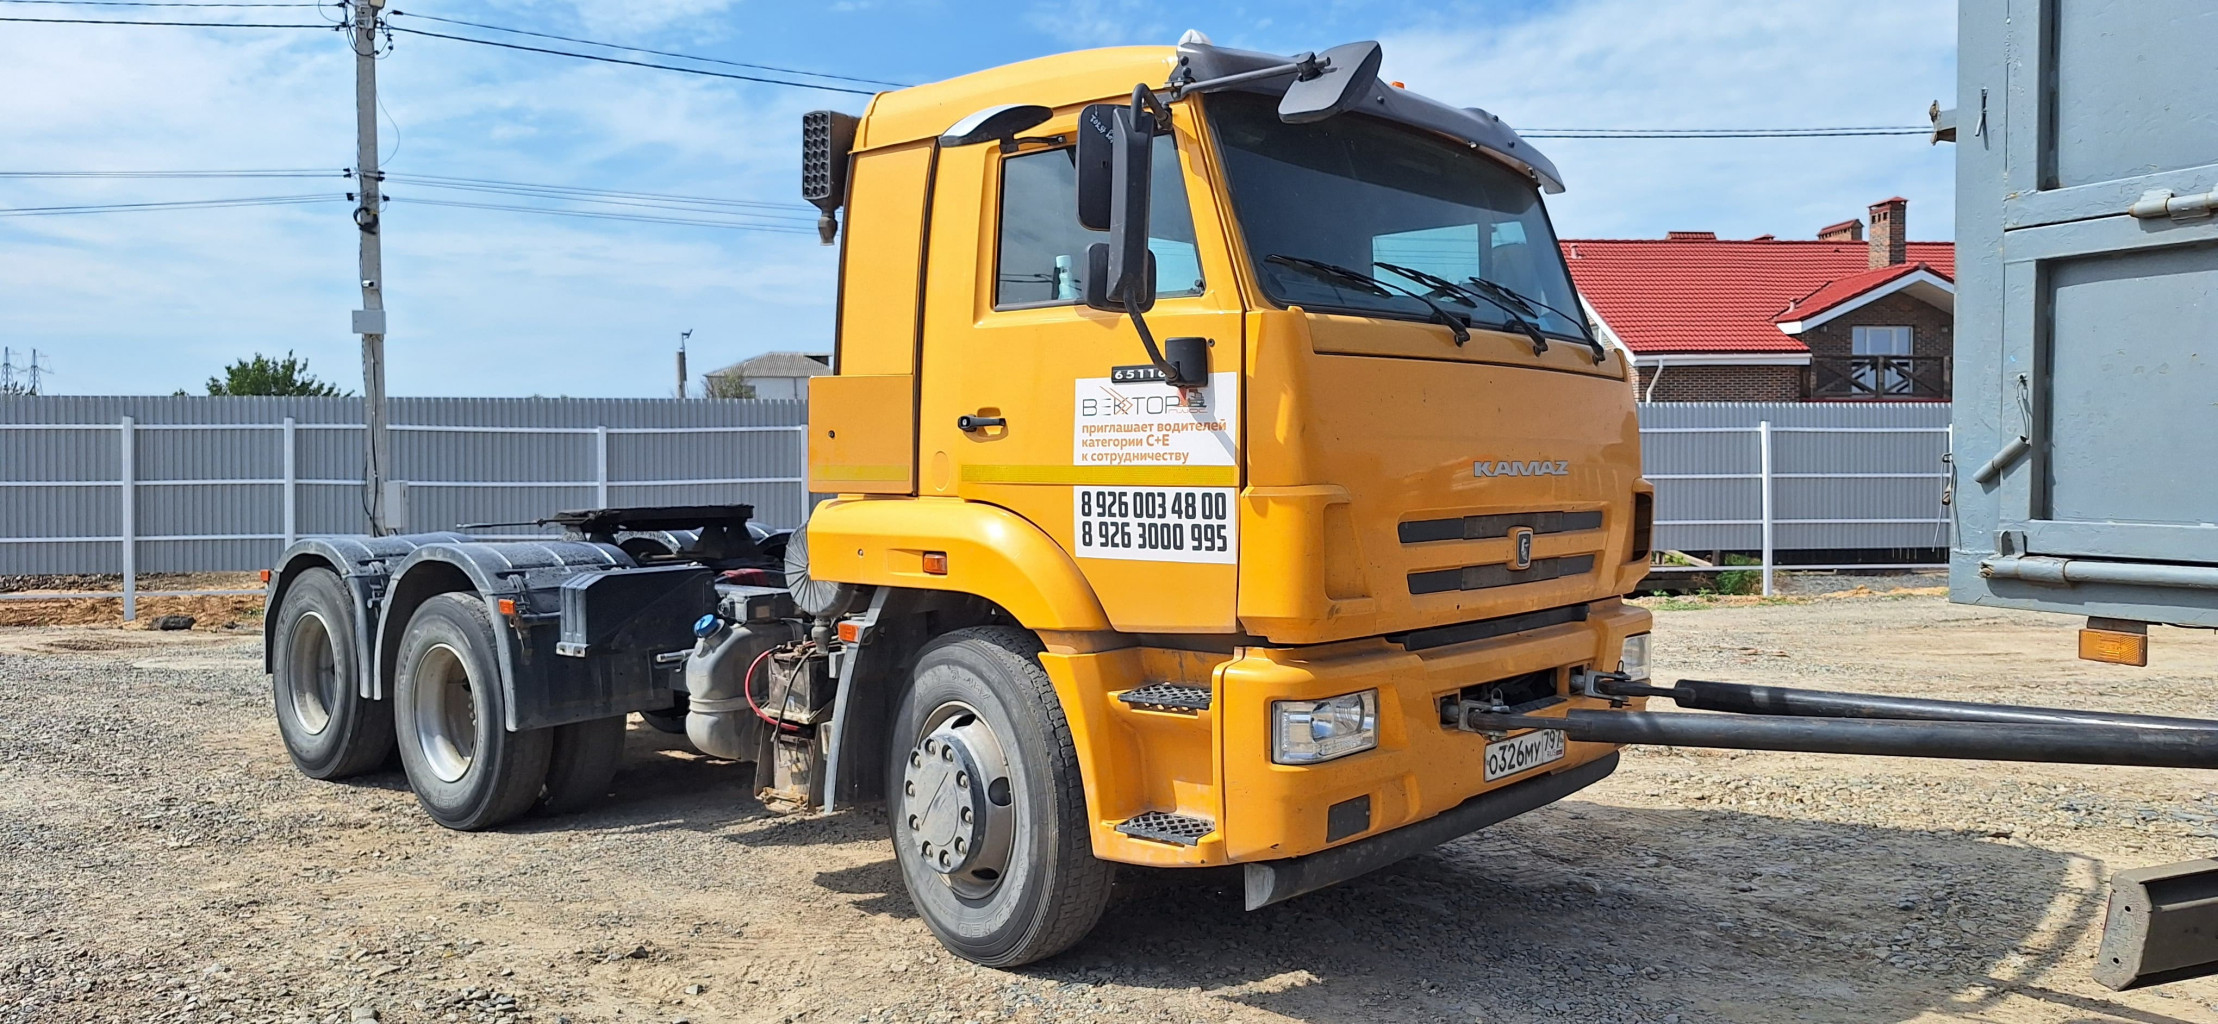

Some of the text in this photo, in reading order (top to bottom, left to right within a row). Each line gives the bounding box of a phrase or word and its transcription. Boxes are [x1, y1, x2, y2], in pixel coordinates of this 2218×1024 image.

[1082, 396, 1181, 416] ВЕКТОР
[1082, 419, 1227, 436] приглашает водителей
[1081, 438, 1143, 449] категории
[1081, 451, 1189, 465] к сотрудничеству
[1473, 460, 1569, 477] KAMAZ
[1081, 491, 1227, 520] 8 926 003 48 00
[1082, 521, 1228, 552] 8 926 3000 995
